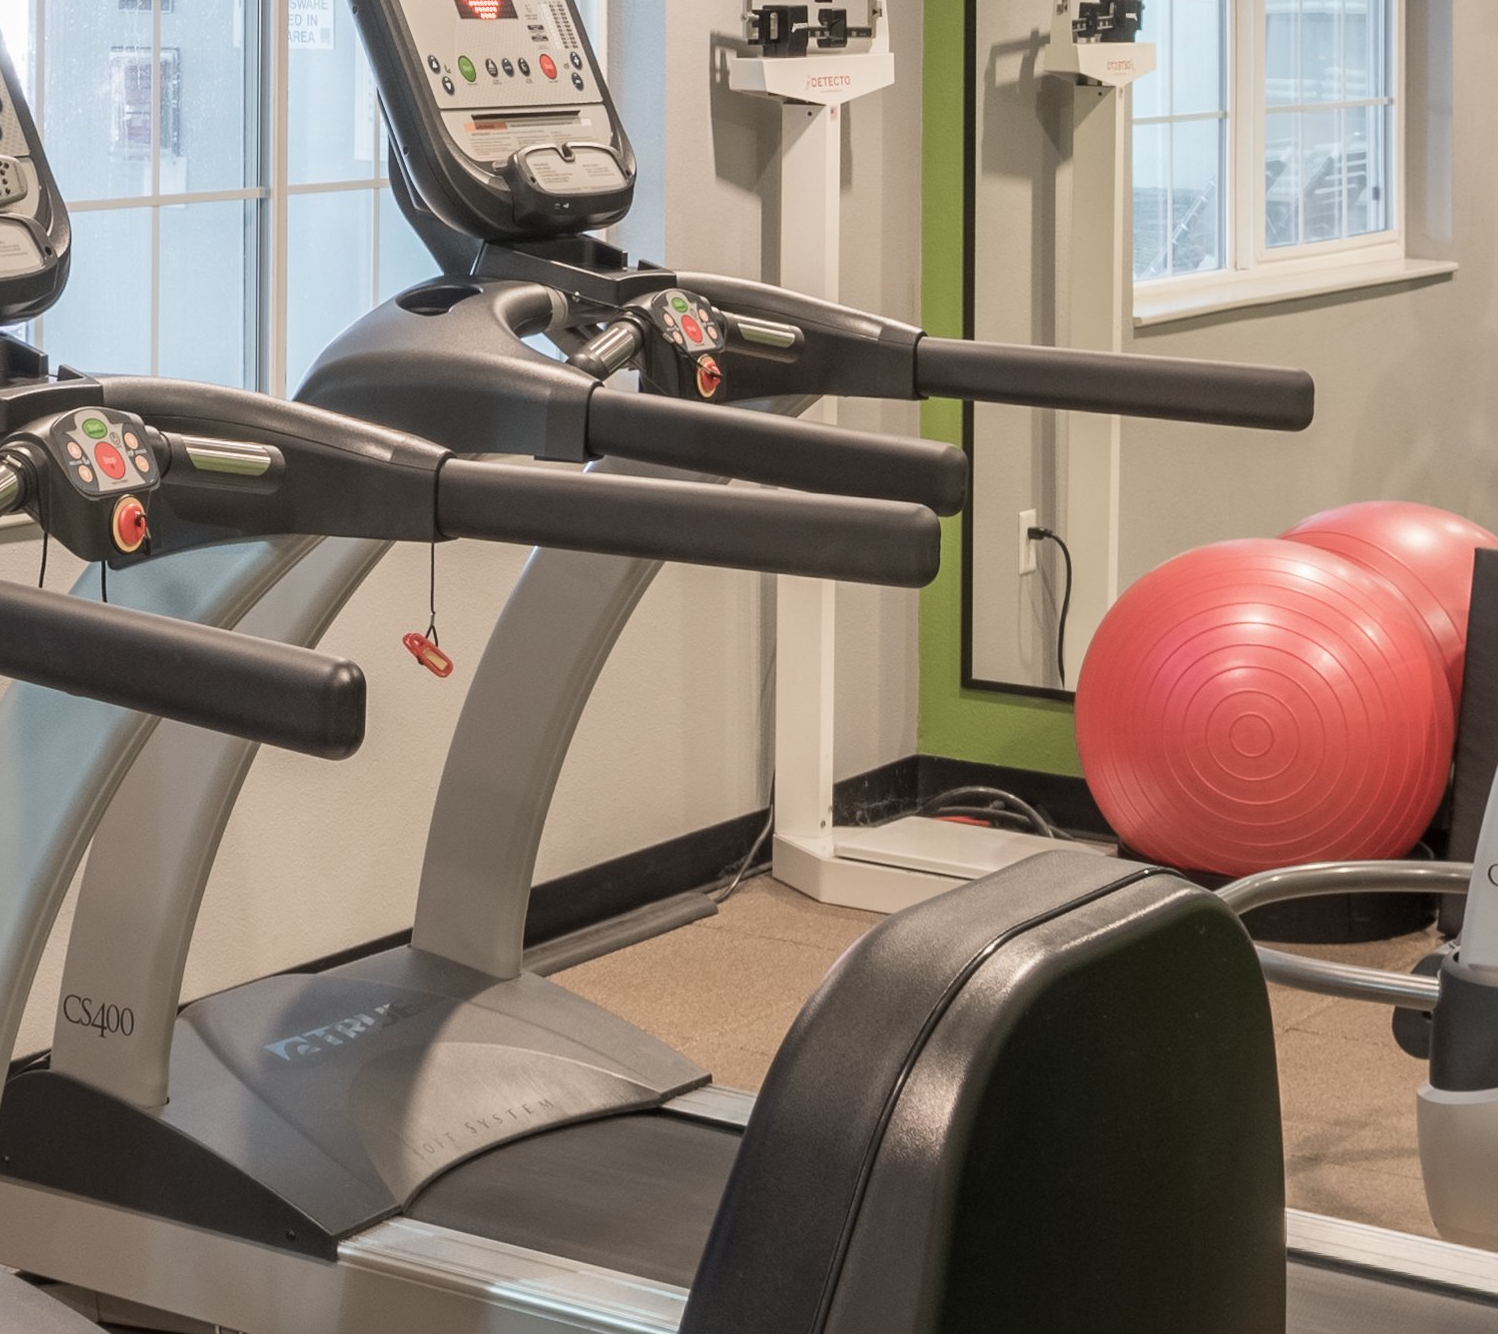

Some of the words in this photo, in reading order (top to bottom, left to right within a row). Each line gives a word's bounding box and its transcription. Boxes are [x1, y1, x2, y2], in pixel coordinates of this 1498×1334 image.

[307, 14, 318, 27] IN
[811, 75, 851, 88] DETECTO
[63, 994, 135, 1038] CS400
[304, 998, 416, 1055] TRUE
[465, 1096, 556, 1135] SYSTEM
